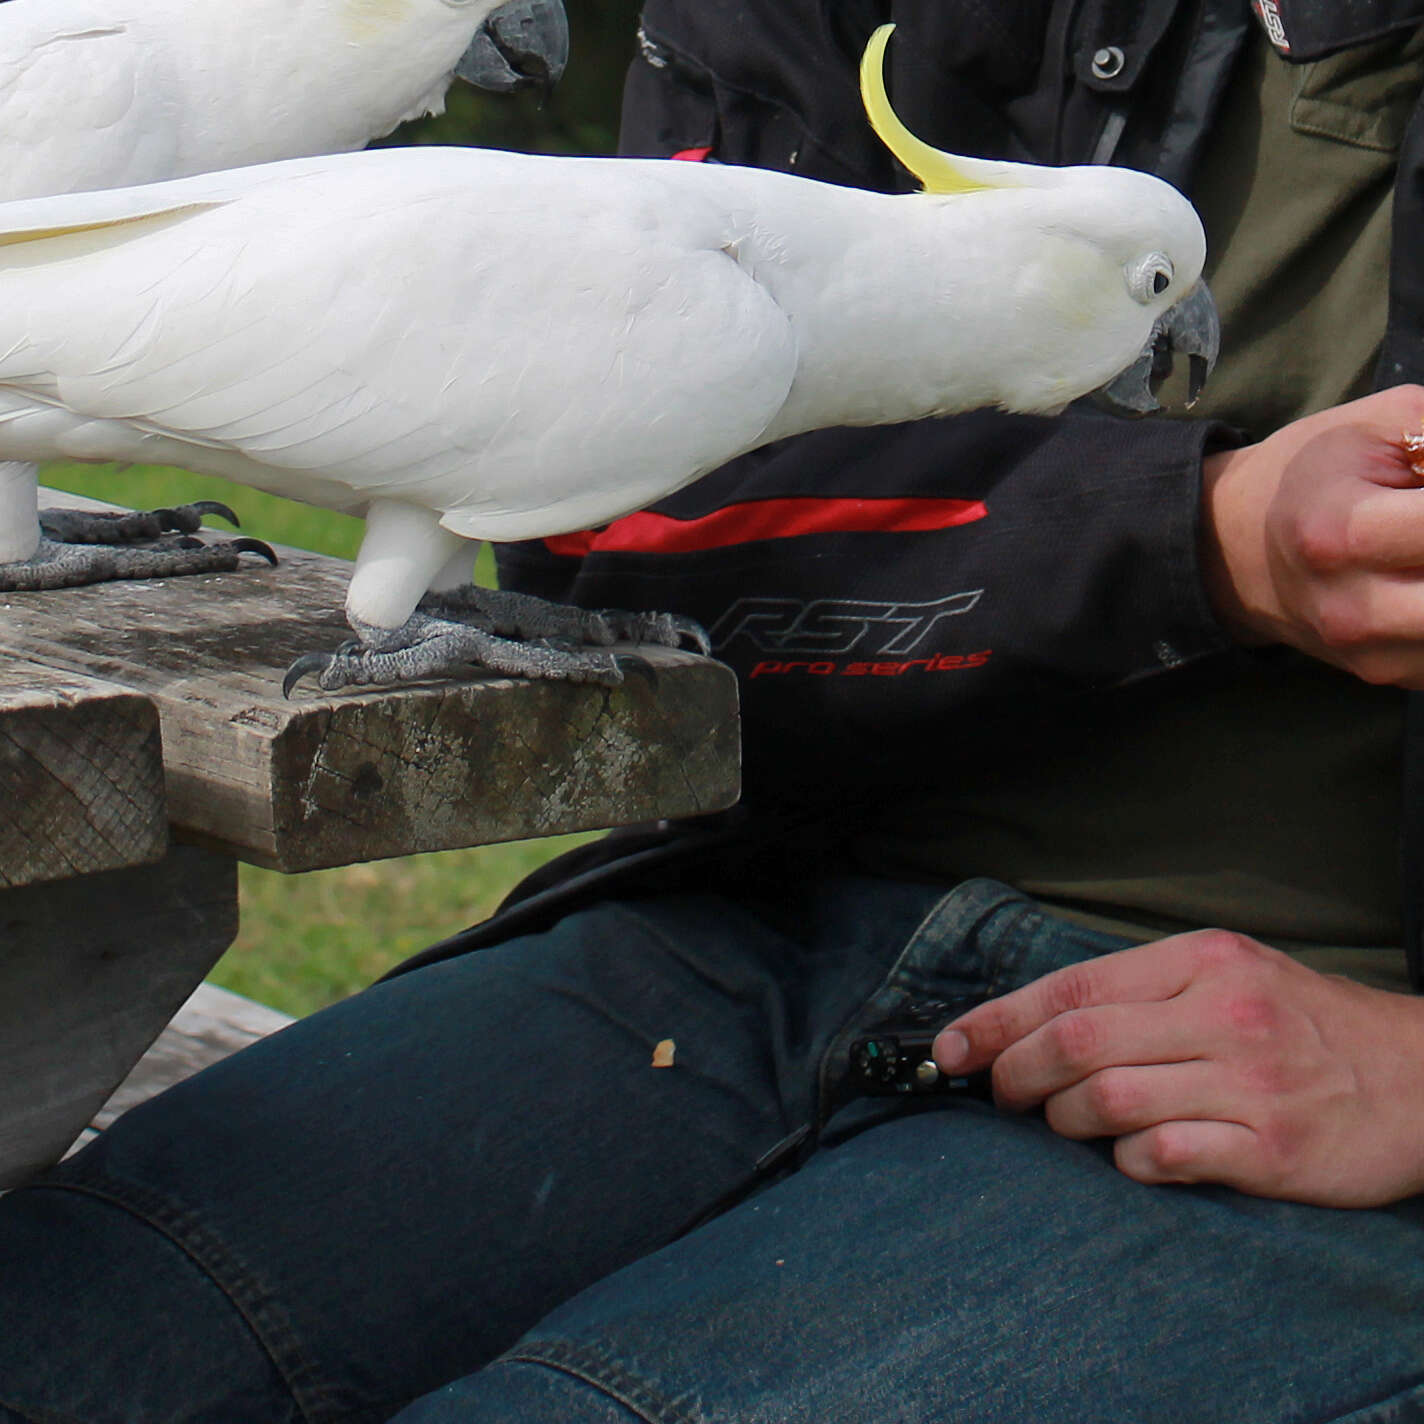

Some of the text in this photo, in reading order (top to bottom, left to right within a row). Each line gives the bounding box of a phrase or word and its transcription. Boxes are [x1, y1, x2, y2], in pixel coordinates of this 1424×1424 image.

[708, 588, 986, 655] RST
[748, 649, 994, 679] pro series
